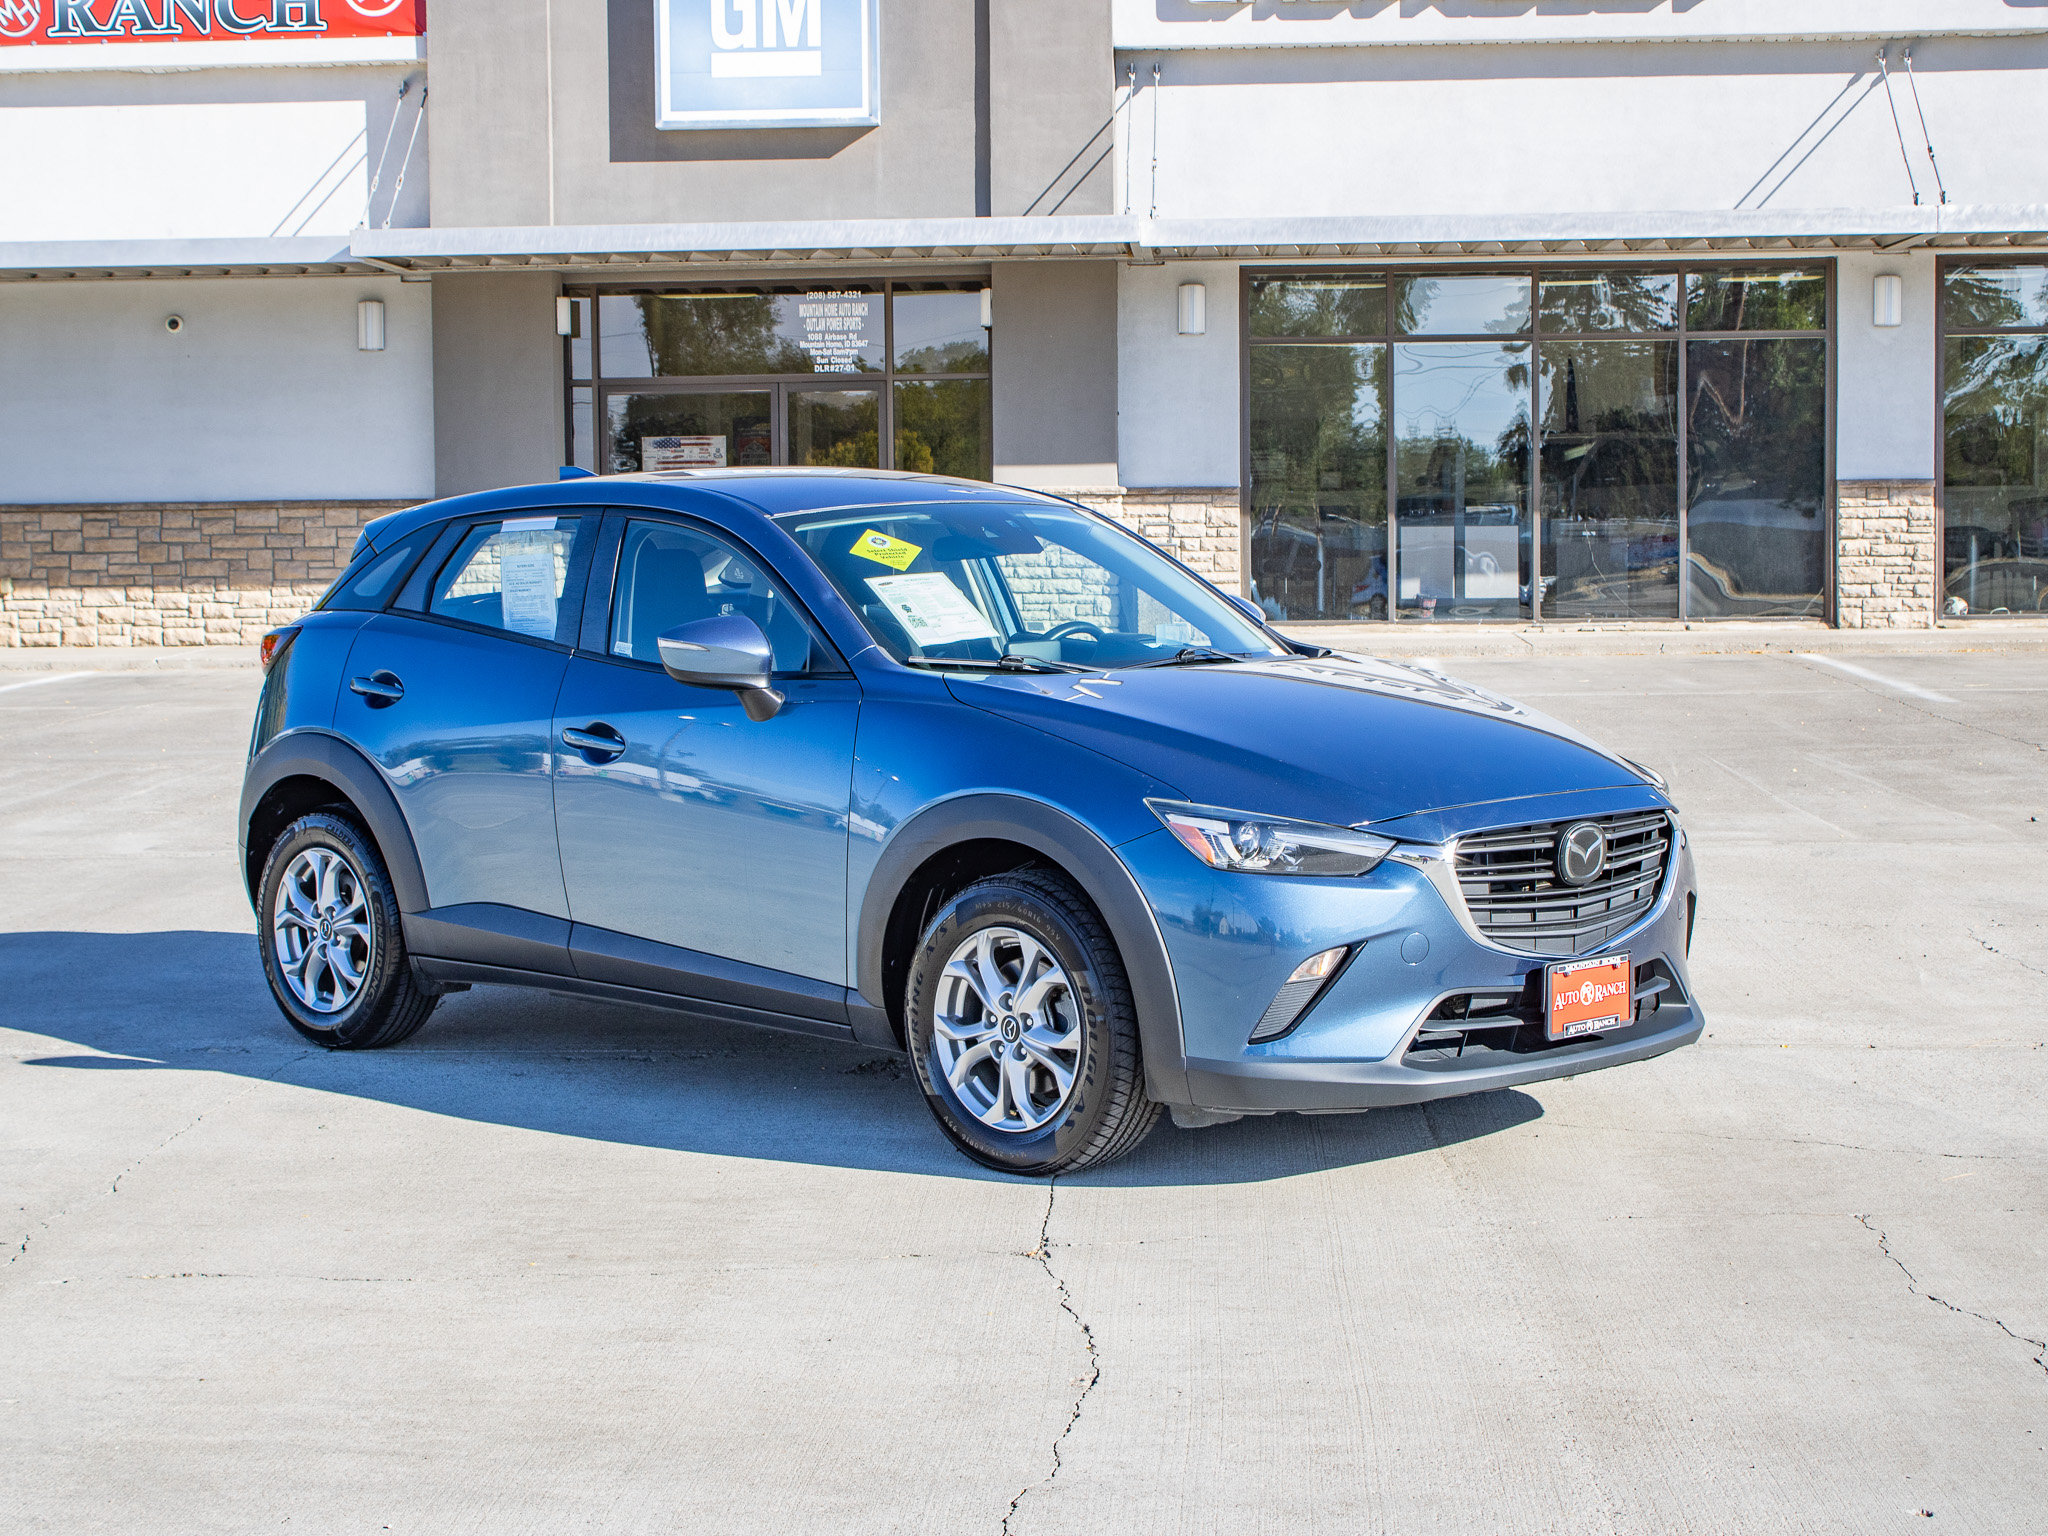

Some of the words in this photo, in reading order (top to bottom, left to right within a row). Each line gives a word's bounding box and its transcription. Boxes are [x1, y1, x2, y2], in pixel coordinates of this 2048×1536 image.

[46, 0, 328, 37] RANCH
[711, 0, 821, 49] GM
[799, 304, 823, 317] MOUNTAIN
[824, 303, 838, 317] HOME
[839, 303, 851, 316] AUTO
[852, 303, 868, 316] RANCH
[806, 318, 825, 331] OUTLAW
[826, 317, 842, 331] POWER
[843, 317, 861, 330] SPORTS
[1553, 990, 1579, 1011] AUTO
[1595, 981, 1626, 1002] RANCH
[1568, 1024, 1585, 1035] AUTO
[1594, 1017, 1616, 1030] RANCH
